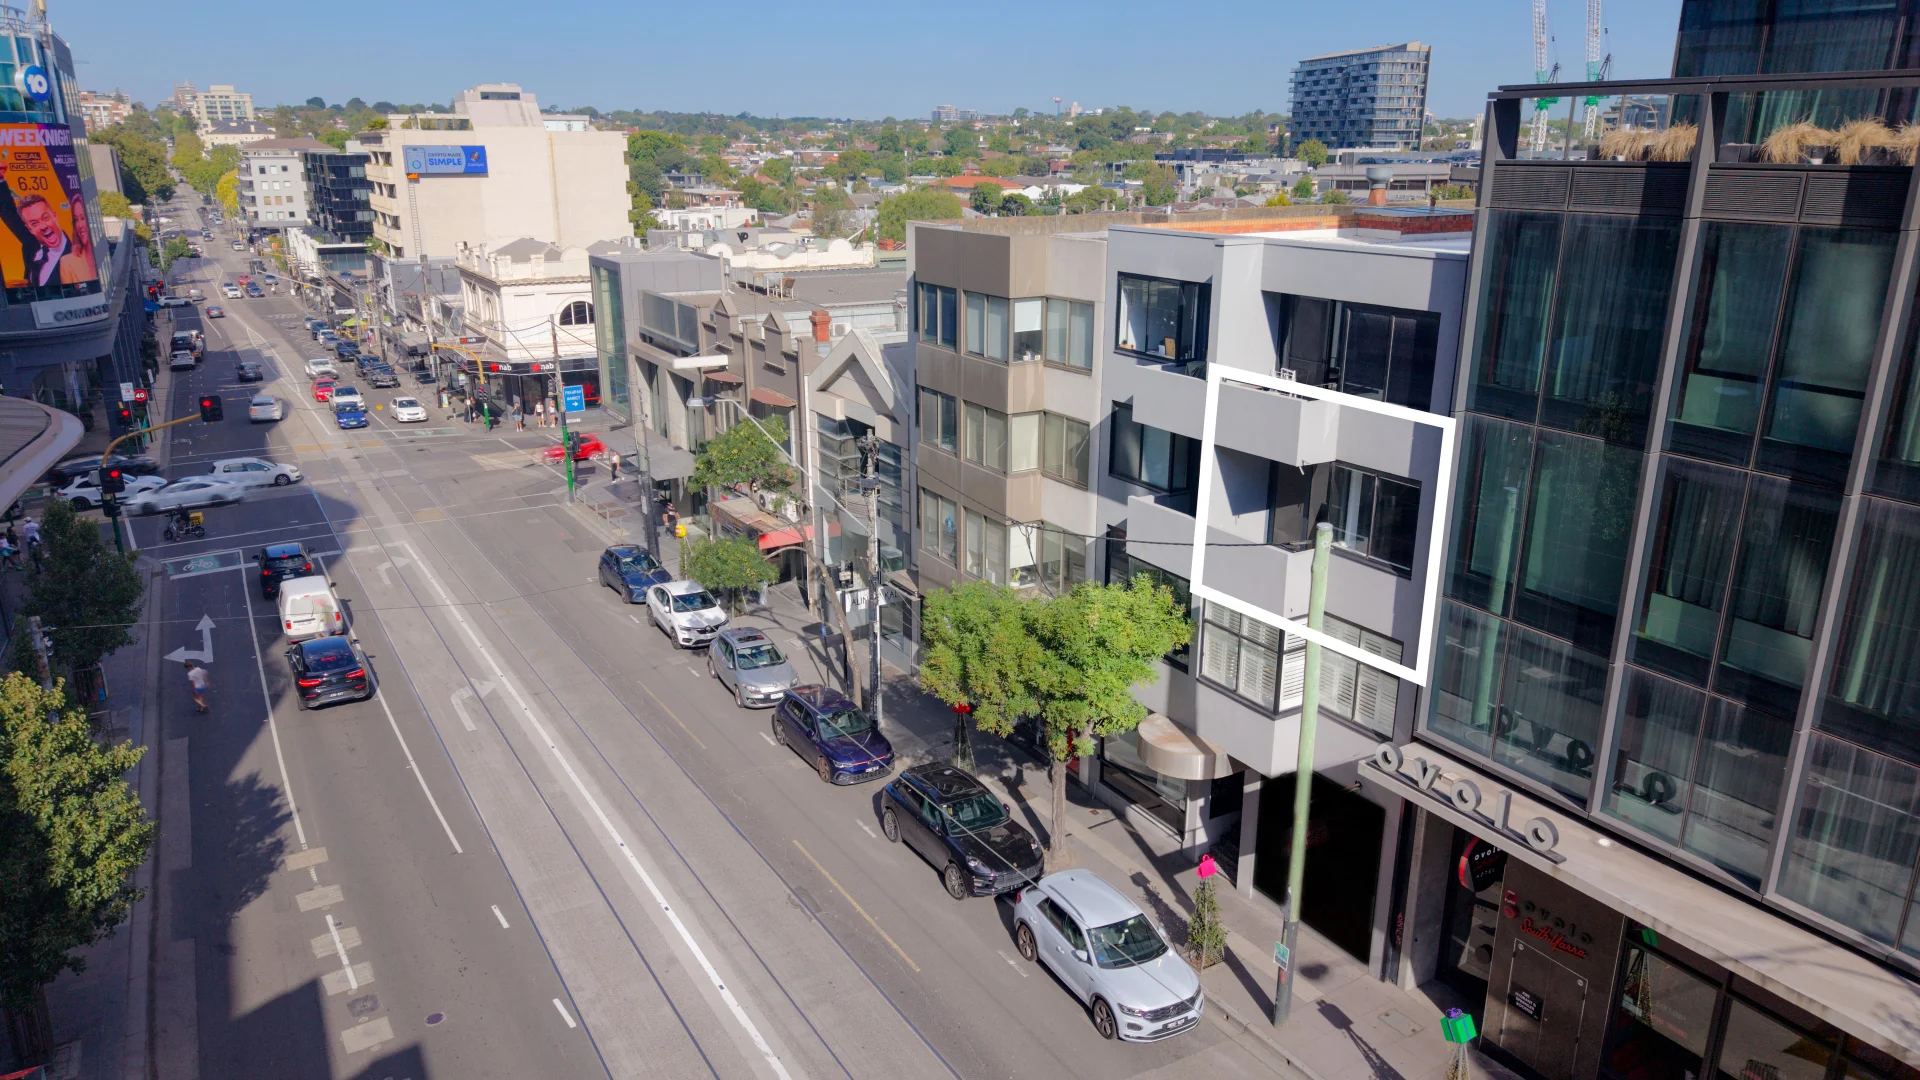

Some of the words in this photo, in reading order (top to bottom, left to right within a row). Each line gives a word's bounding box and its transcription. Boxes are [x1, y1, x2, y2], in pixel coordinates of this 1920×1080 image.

[27, 74, 48, 94] 10
[428, 157, 463, 166] SIMPLE
[17, 176, 48, 191] 6.30
[499, 363, 512, 371] nab
[1376, 742, 1559, 851] ovolo
[1520, 918, 1551, 941] South
[1550, 933, 1588, 959] Yarra
